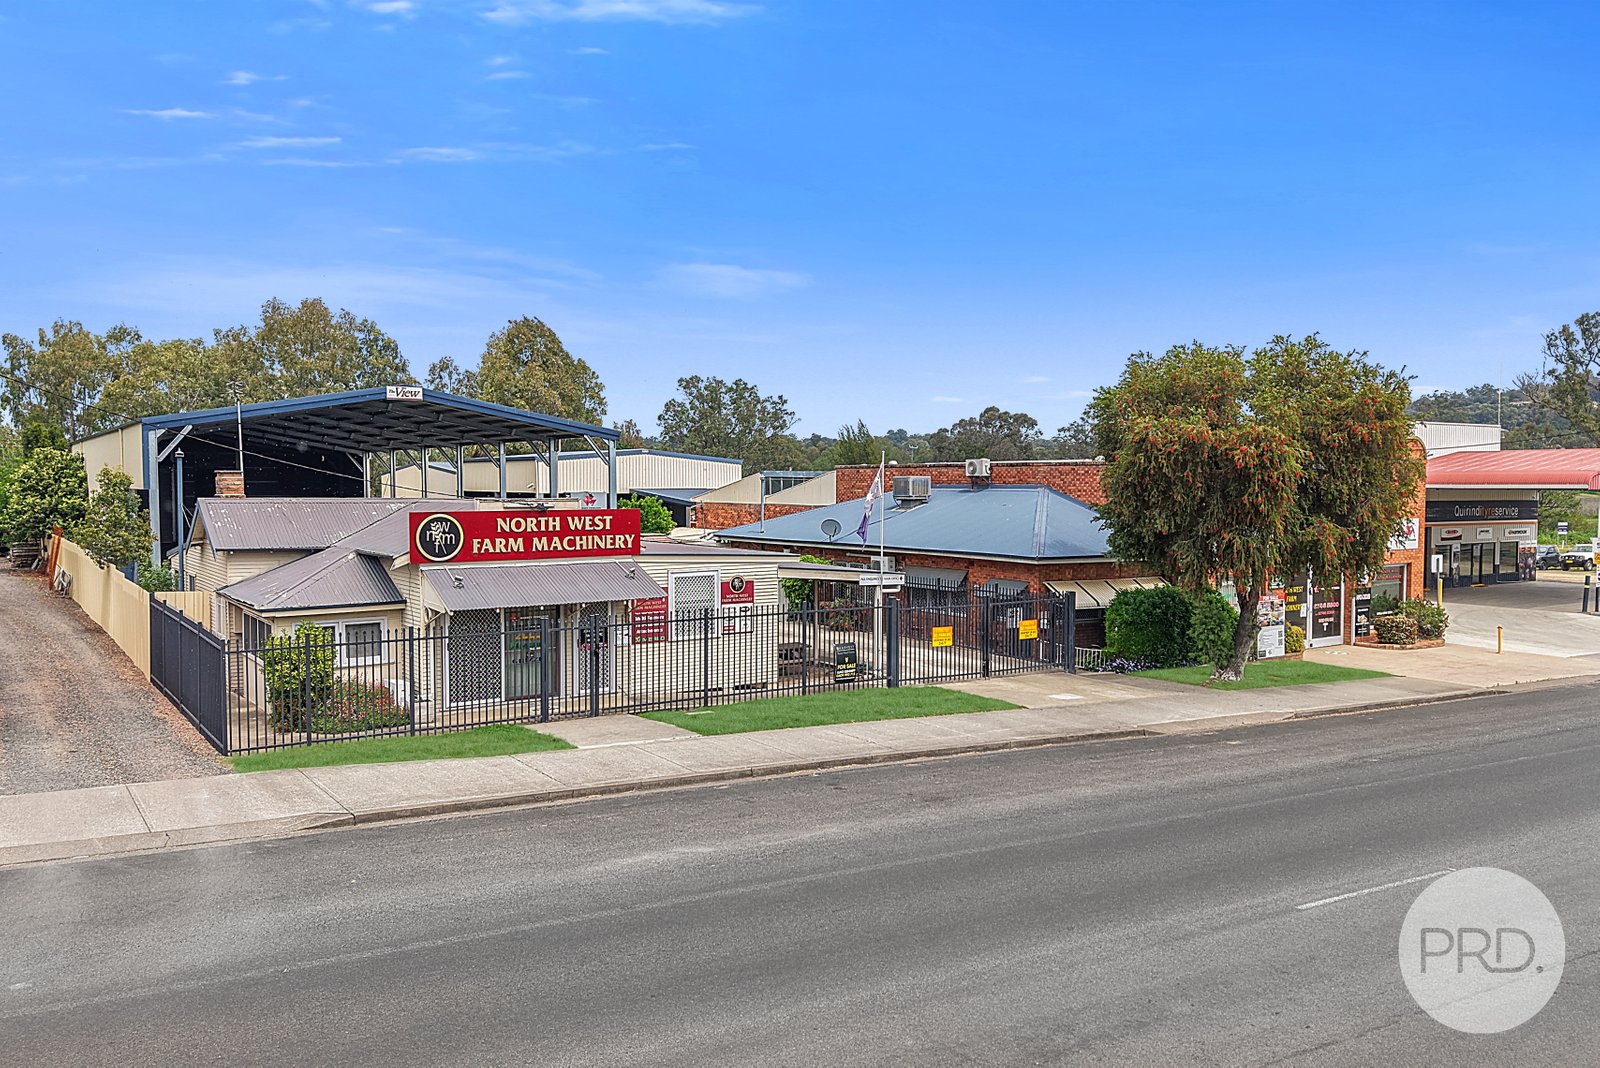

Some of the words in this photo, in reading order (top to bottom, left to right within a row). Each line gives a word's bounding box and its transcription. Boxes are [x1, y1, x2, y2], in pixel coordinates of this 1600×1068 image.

[395, 387, 420, 398] View
[496, 516, 561, 533] NORTH
[567, 515, 613, 532] WEST
[472, 537, 525, 554] FARM
[531, 534, 635, 552] MACHINERY
